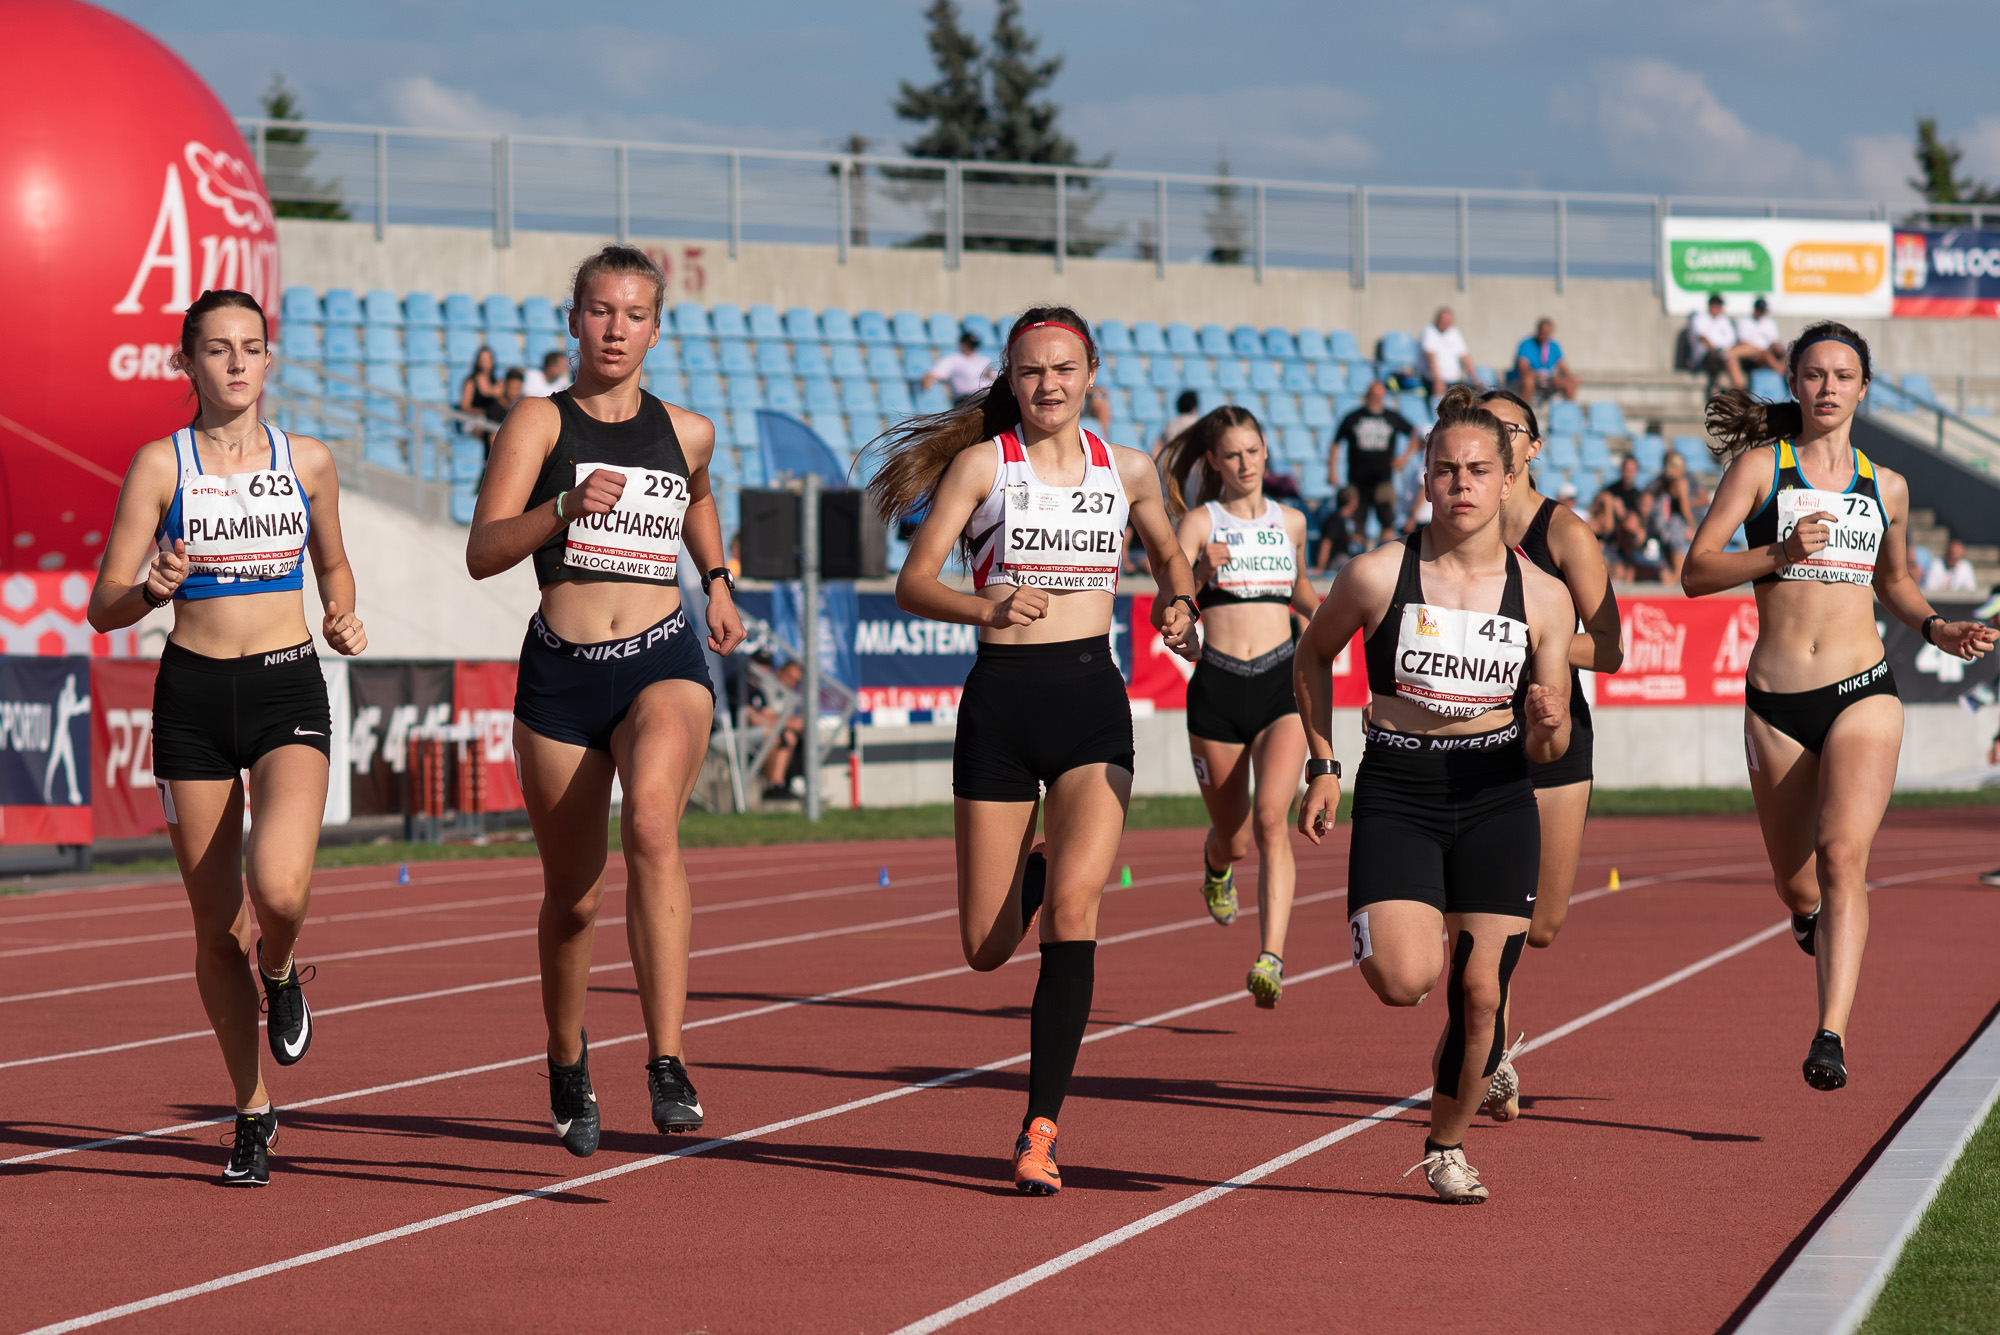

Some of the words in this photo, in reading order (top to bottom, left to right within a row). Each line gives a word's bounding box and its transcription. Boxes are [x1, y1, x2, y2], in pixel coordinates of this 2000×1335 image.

[249, 474, 293, 497] 623
[644, 474, 687, 501] 292
[1071, 491, 1115, 514] 237
[1843, 498, 1871, 517] 72
[189, 511, 304, 541] PLAMINIAK
[1257, 531, 1284, 545] 857
[1011, 528, 1117, 553] SZMIGIEL
[222, 552, 271, 562] MISTRZOSTWA
[272, 550, 292, 558] POLSKI
[572, 553, 651, 575] WŁOCŁAWEK
[584, 545, 602, 553] PZLA
[602, 548, 649, 559] MISTRZOSTWA
[649, 554, 668, 562] POLSKI
[1012, 573, 1085, 587] WŁOCŁAWEK
[1087, 577, 1108, 587] 2021
[1782, 567, 1850, 581] WŁOCŁAWEK
[1853, 573, 1869, 583] 2021
[573, 637, 642, 661] NIKE
[647, 610, 685, 649] PRO
[855, 619, 976, 655] MIASTEM
[1478, 619, 1512, 644] 41
[264, 649, 298, 666] NIKE
[1401, 649, 1519, 684] CZERNIAK
[1838, 673, 1870, 695] NIKE
[1872, 661, 1888, 682] PRO
[1413, 688, 1429, 696] PZLA
[1429, 692, 1476, 703] MISTRZOSTWA
[0, 702, 51, 751] PORTU
[1376, 732, 1421, 750] PRO
[1429, 737, 1484, 751] NIKE
[1485, 725, 1518, 747] PRO
[1351, 921, 1364, 960] 3
